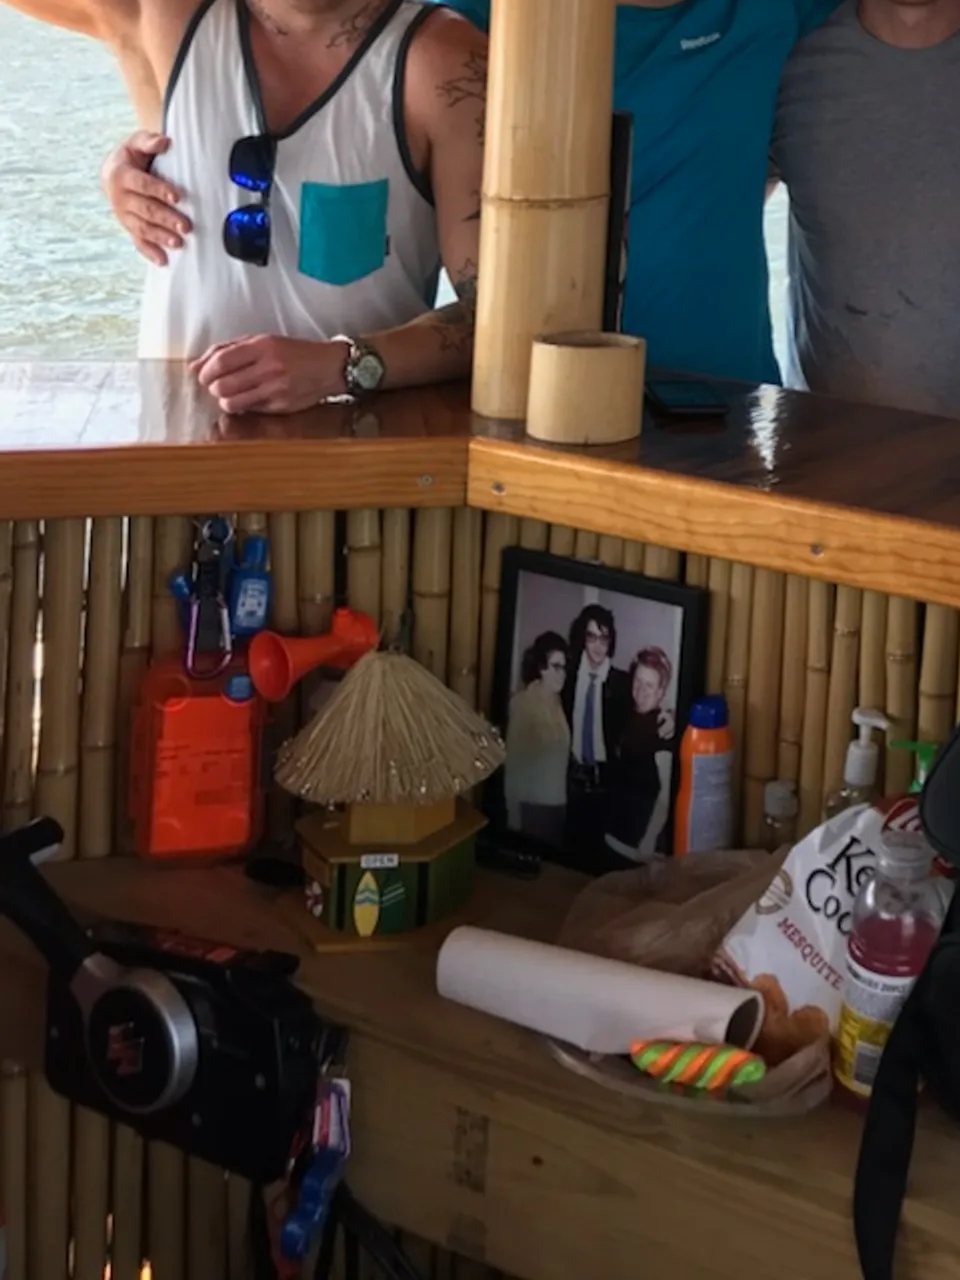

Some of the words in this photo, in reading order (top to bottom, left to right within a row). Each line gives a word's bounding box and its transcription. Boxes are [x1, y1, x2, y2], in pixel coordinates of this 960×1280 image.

[825, 835, 876, 898] Ke
[805, 868, 852, 936] Coo
[776, 917, 844, 990] MESQUITE
